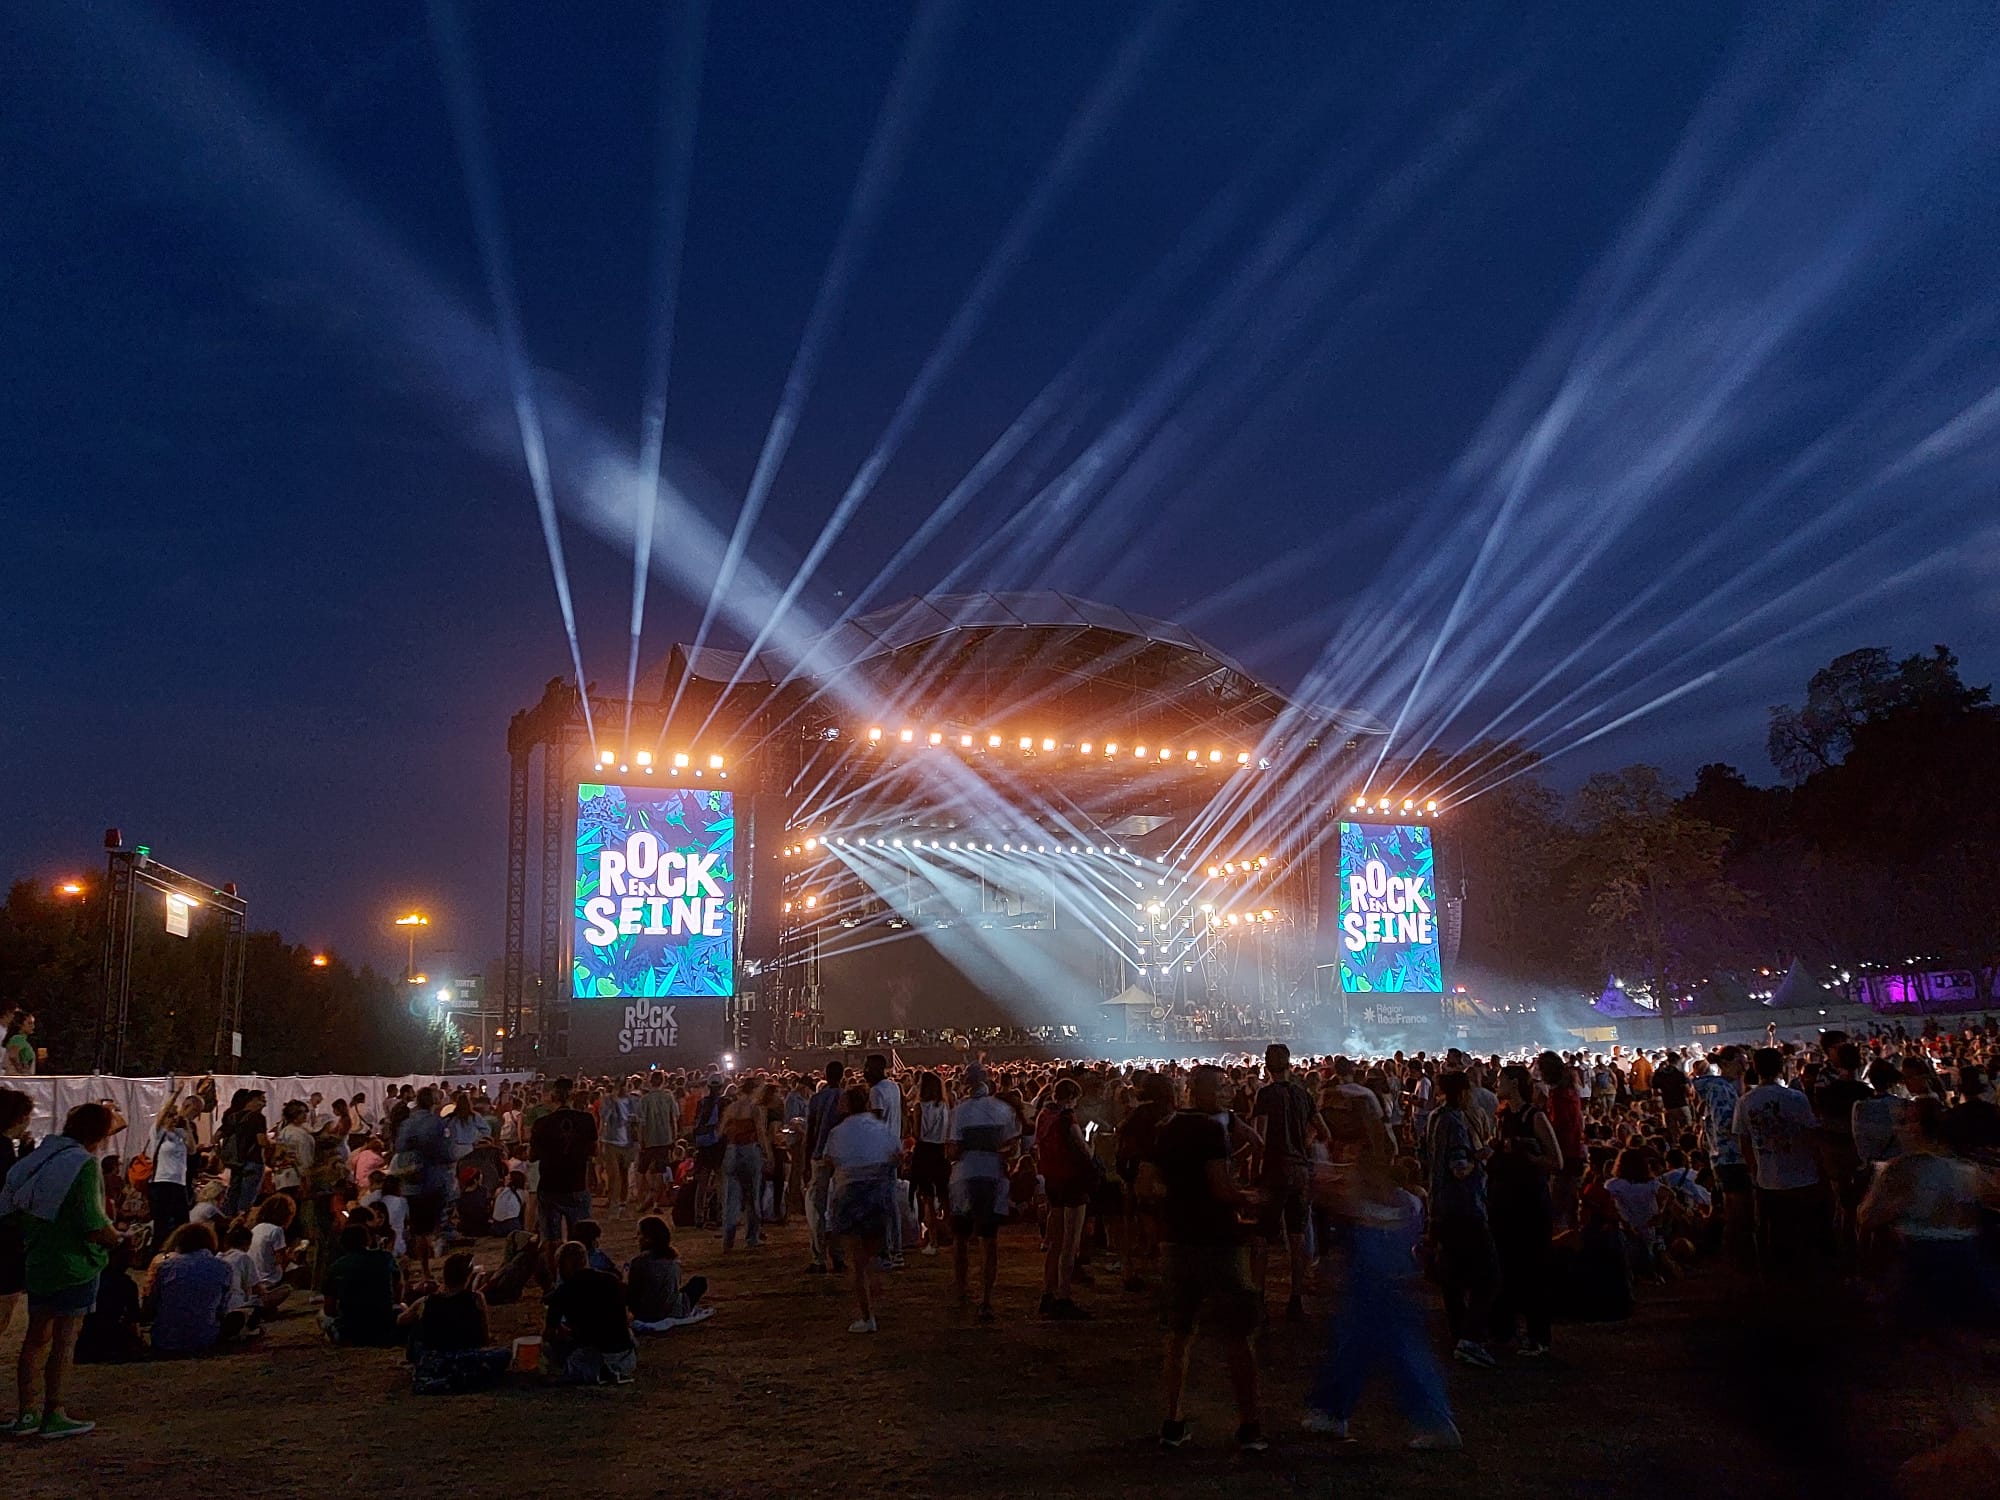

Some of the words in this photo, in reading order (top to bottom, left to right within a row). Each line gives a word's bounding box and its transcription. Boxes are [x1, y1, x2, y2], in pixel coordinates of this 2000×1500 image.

[599, 831, 725, 898] ROCK
[628, 878, 657, 897] EN
[1350, 860, 1430, 913] ROCK
[1370, 898, 1387, 912] EN
[584, 897, 725, 947] SEINE
[1343, 912, 1433, 952] SEINE
[624, 998, 679, 1028] ROCK
[1376, 1003, 1404, 1015] Région
[618, 1027, 679, 1053] SEINE
